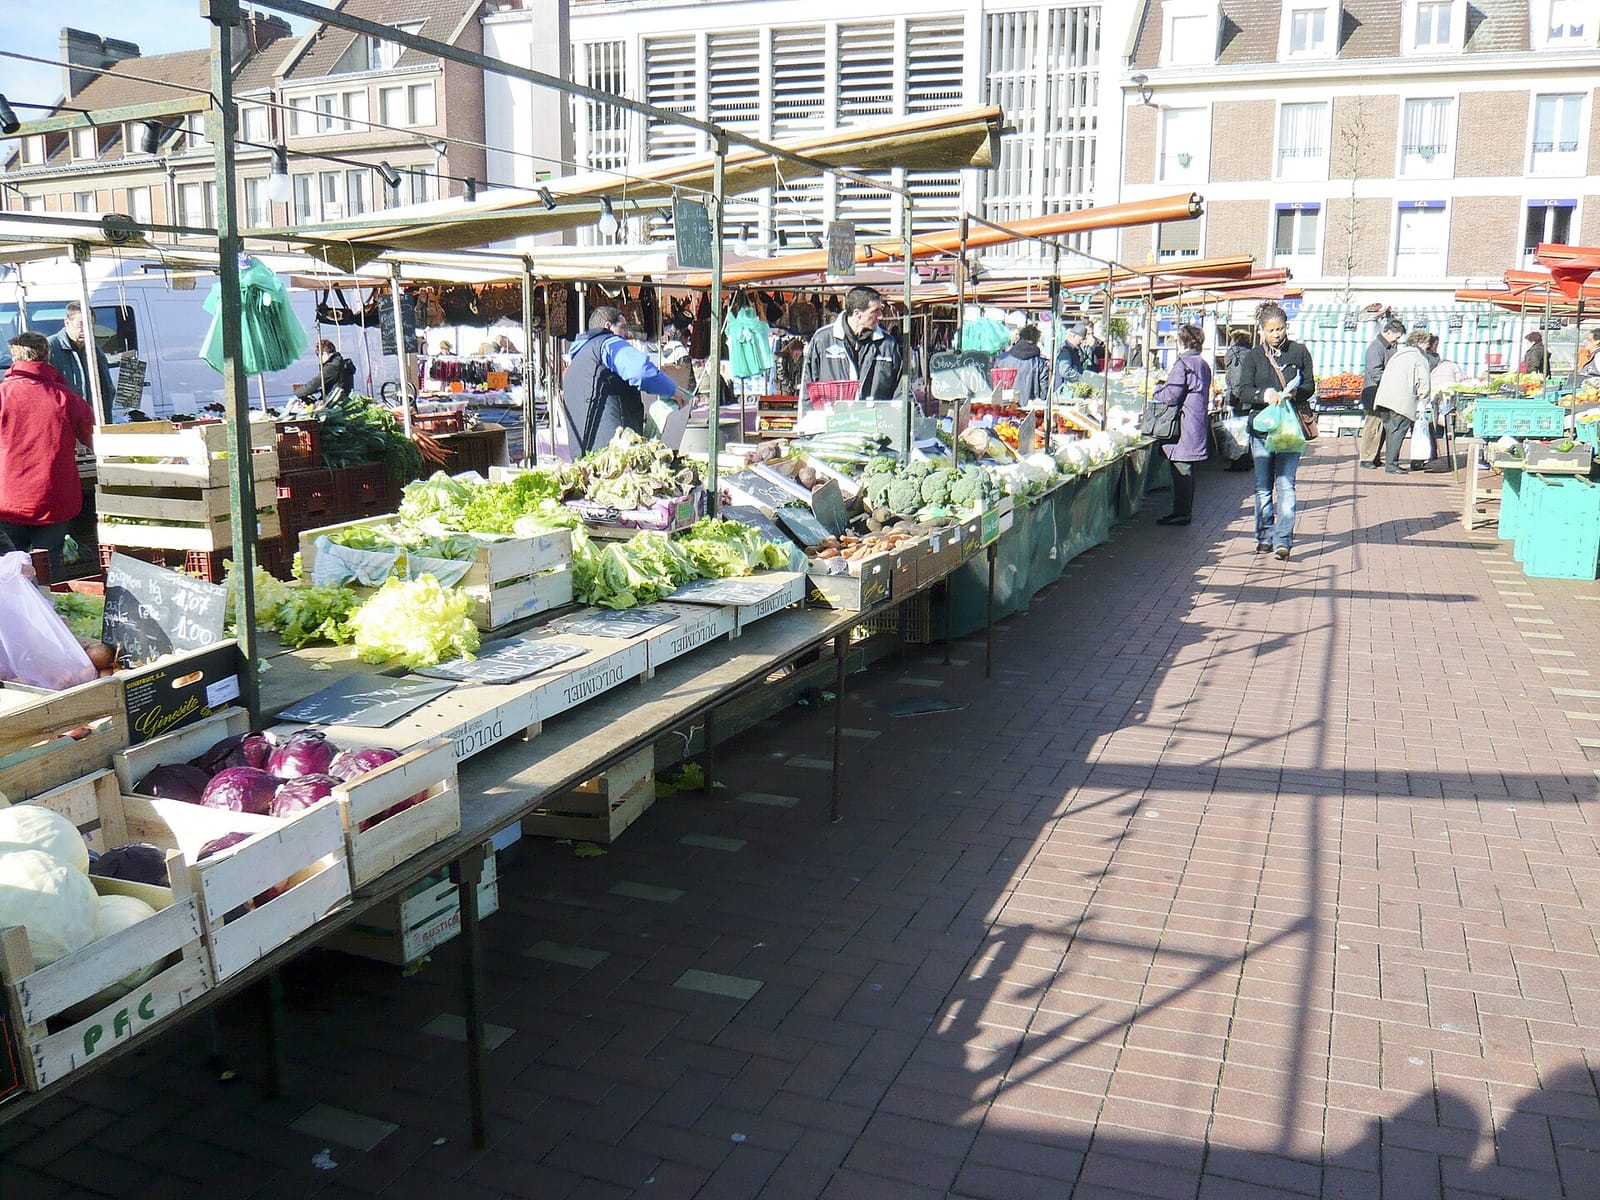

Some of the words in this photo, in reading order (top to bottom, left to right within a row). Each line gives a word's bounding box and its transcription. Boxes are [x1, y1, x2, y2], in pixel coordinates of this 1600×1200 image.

[1283, 301, 1299, 310] CL
[754, 591, 792, 616] DULCIMIEL
[671, 623, 716, 653] DULCIMIEL
[564, 665, 623, 704] DULCIMIEL
